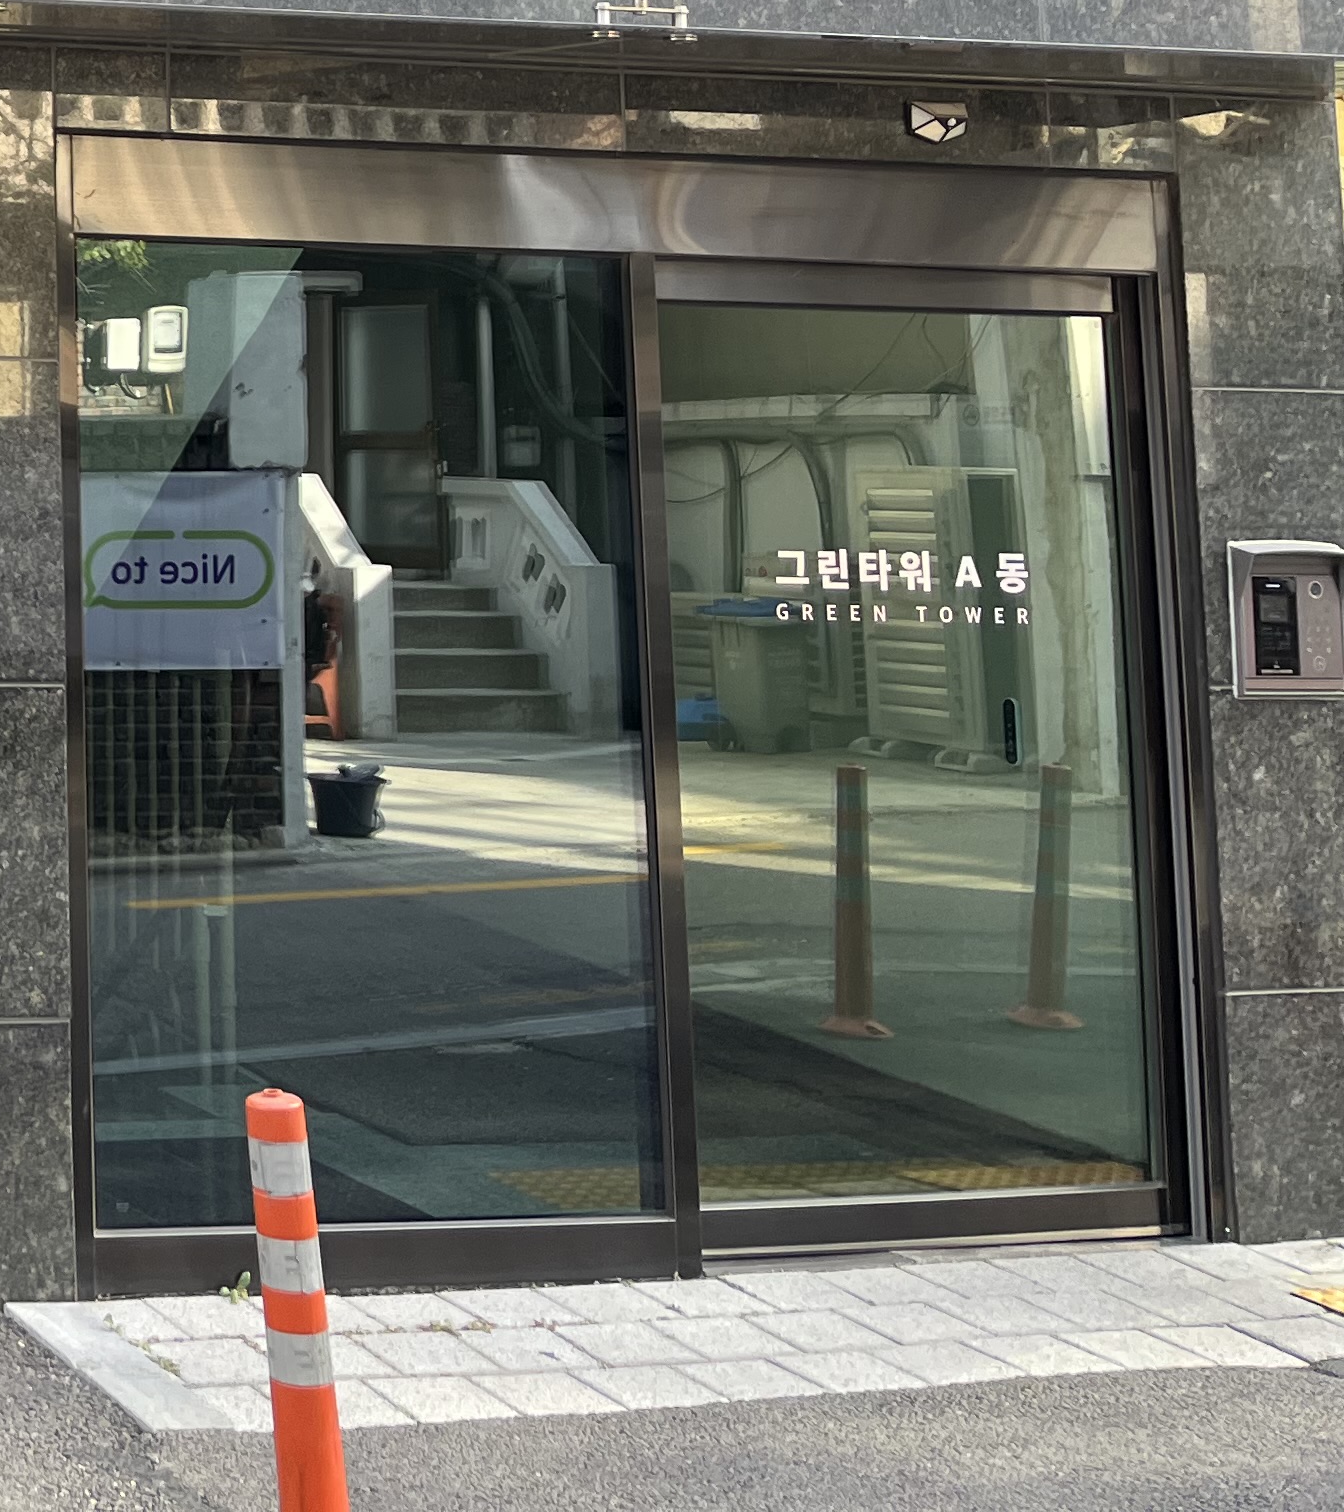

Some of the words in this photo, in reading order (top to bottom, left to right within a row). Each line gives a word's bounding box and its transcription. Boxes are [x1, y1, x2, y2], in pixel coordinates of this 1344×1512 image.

[775, 548, 932, 592] 그린타워
[776, 603, 888, 623] GREEN
[915, 605, 1030, 626] TOWER
